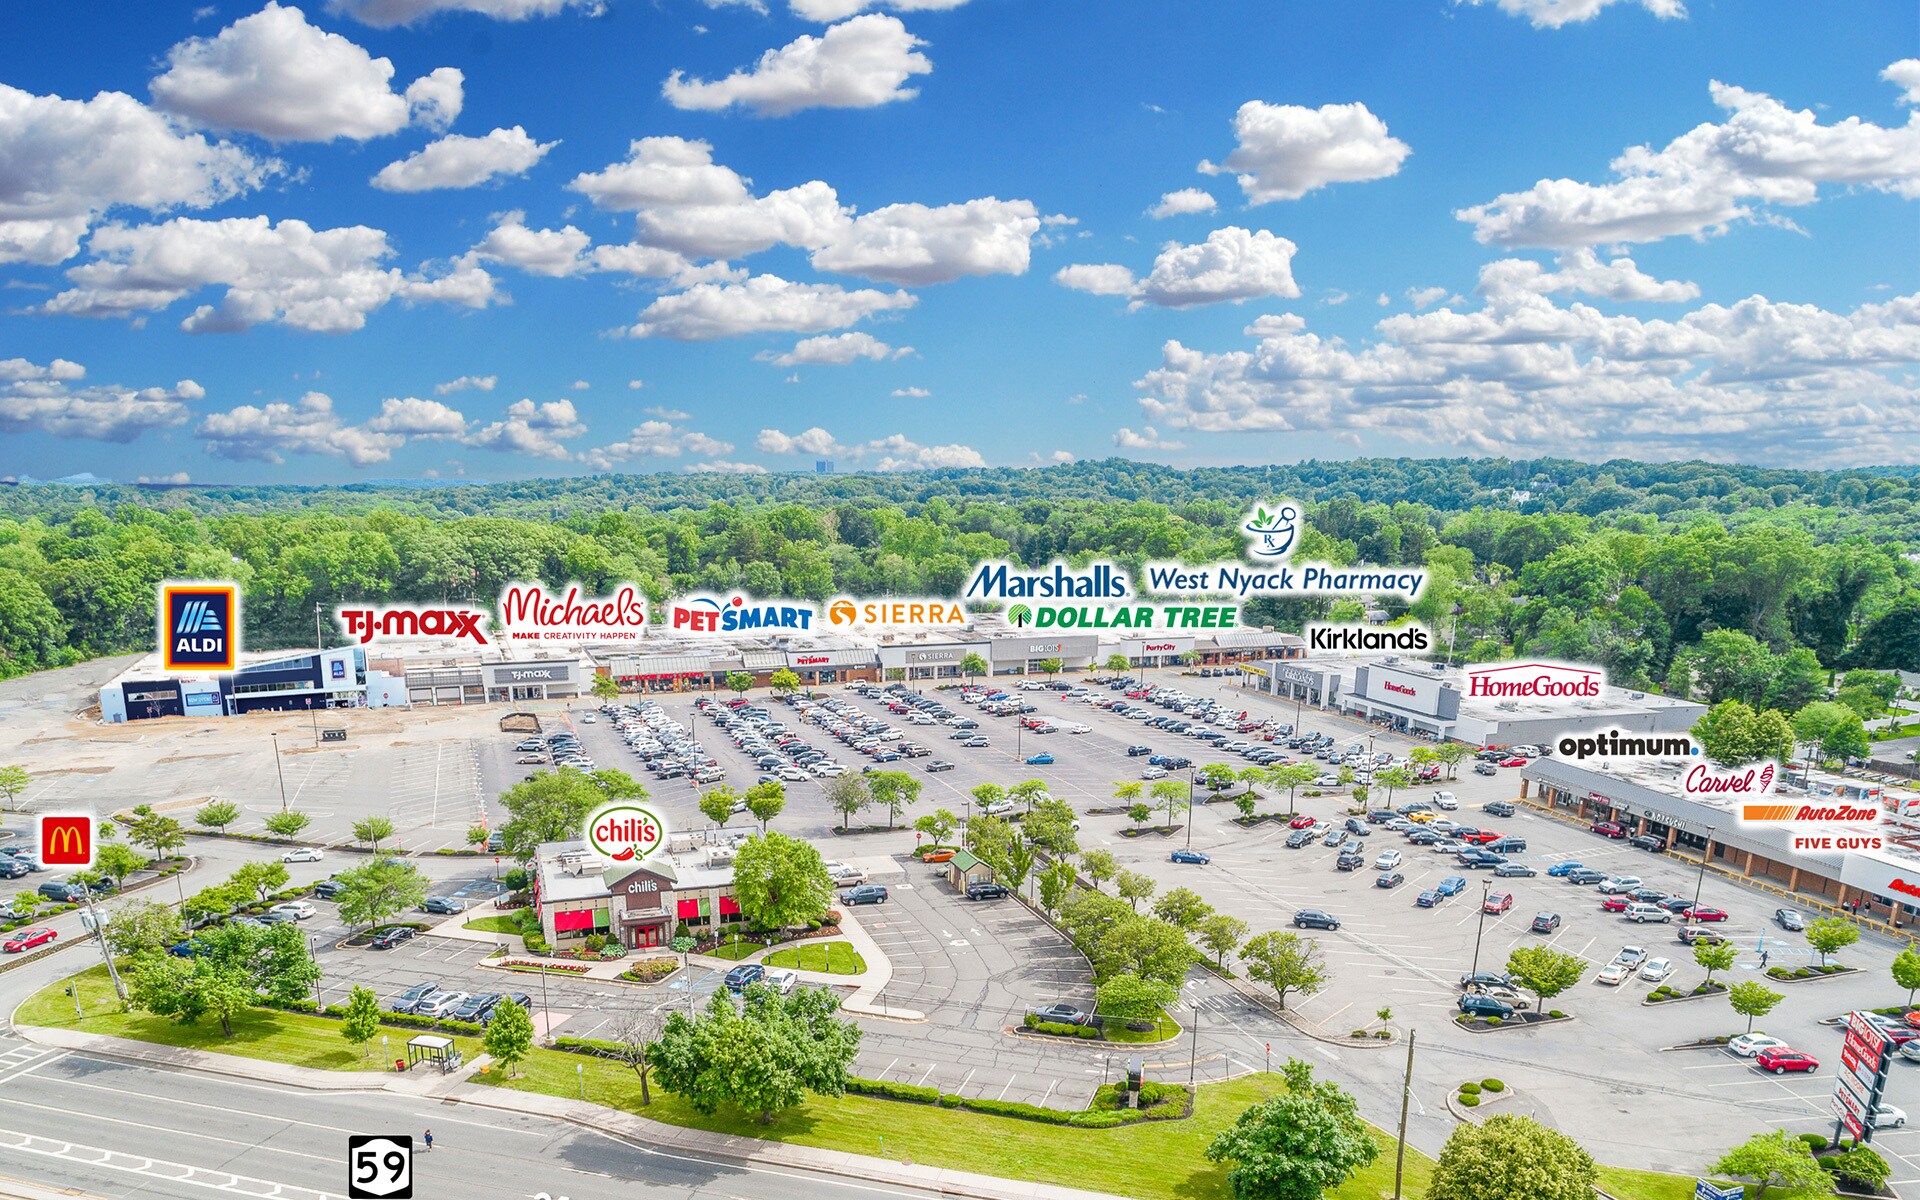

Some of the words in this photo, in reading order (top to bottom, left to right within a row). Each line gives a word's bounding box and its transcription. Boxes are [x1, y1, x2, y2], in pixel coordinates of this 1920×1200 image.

[927, 652, 954, 660] SIERRA
[1384, 681, 1416, 696] HomeGoods
[628, 880, 657, 893] chili's
[1888, 879, 1920, 898] Auto
[1851, 1013, 1864, 1035] BIG
